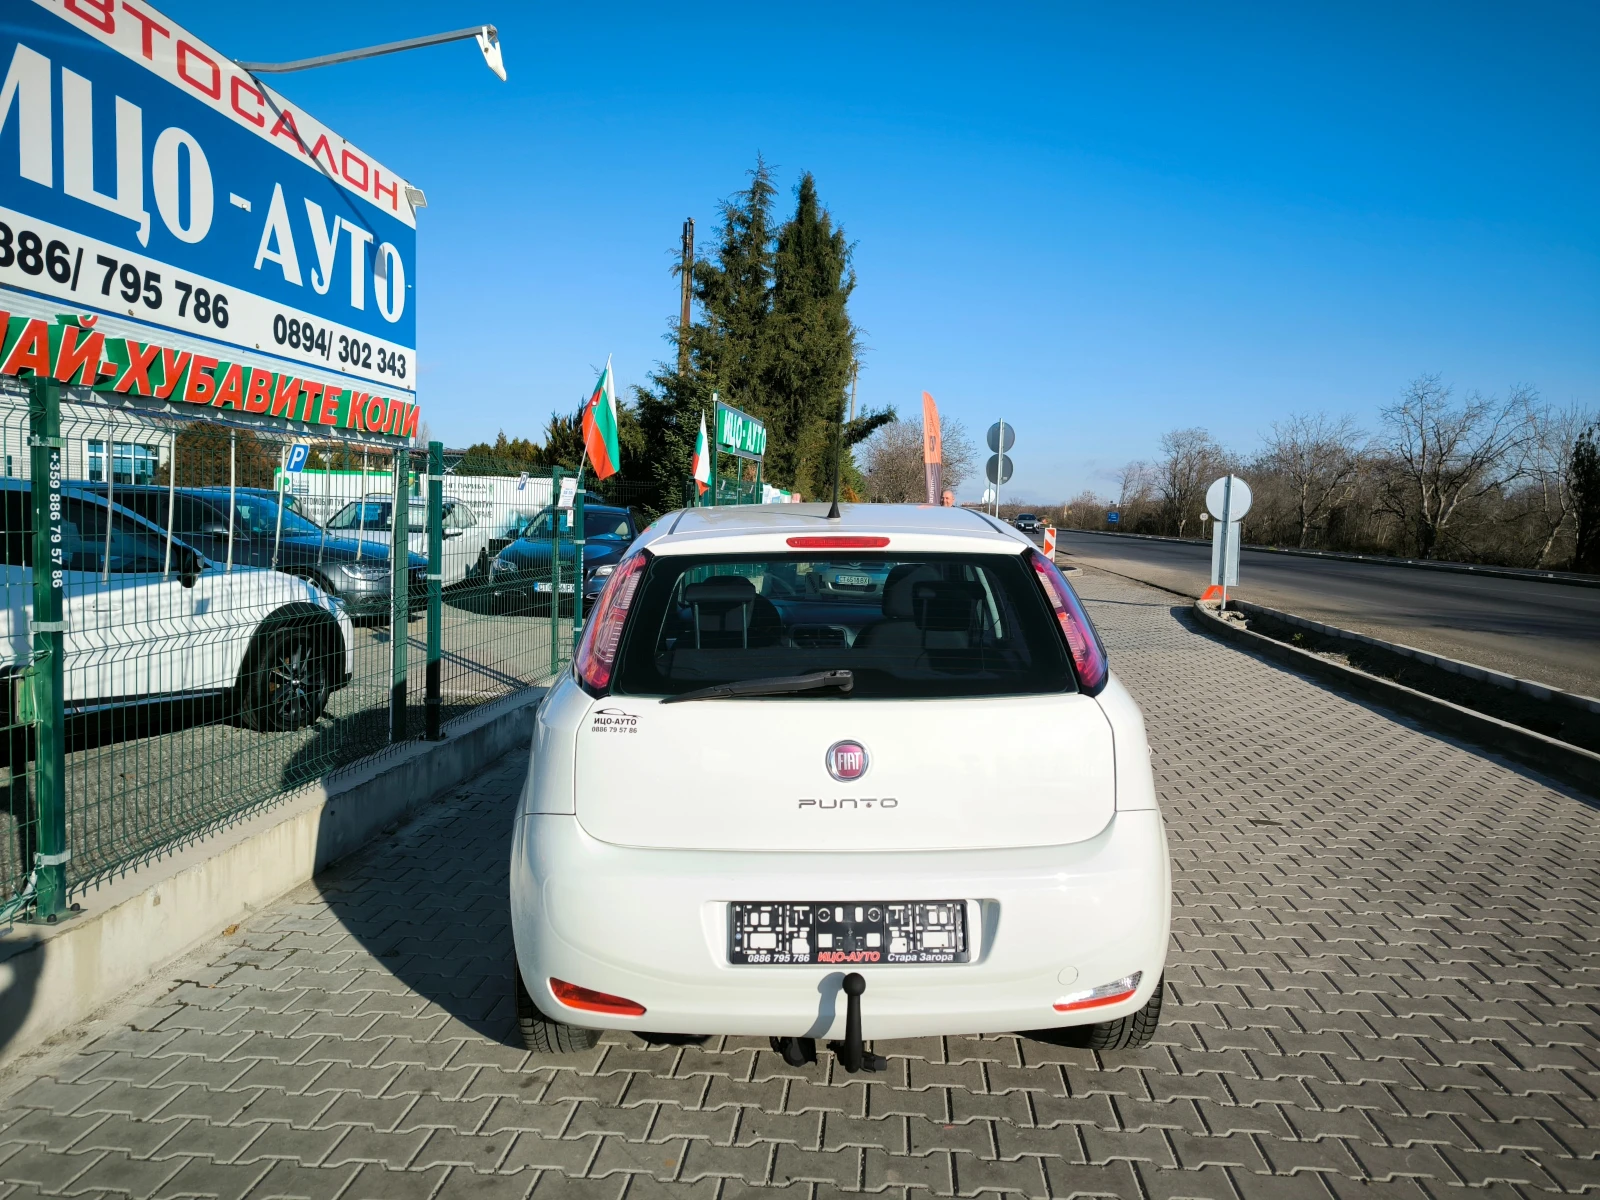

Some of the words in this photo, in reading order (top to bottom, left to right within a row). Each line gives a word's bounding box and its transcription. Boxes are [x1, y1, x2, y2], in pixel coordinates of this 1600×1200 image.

[50, 0, 398, 211] ВТОСАЛОН
[96, 254, 162, 310] 795
[175, 280, 229, 329] 786
[273, 314, 333, 361] 0894/
[338, 335, 372, 369] 302
[377, 347, 406, 379] 343
[0, 310, 342, 425] АЙ-ХУБАВИТЕ
[346, 391, 420, 438] КОЛИ
[723, 409, 767, 456] ИЦО-АУТО
[49, 452, 61, 489] +359
[49, 493, 61, 521] 886
[50, 525, 62, 543] 79
[51, 548, 62, 565] 57
[51, 570, 63, 588] 86
[594, 717, 637, 725] ИЦО-АУТО
[837, 752, 861, 770] FIAT
[798, 798, 899, 809] PUNTO
[747, 954, 771, 963] 0886
[773, 954, 791, 963] 795
[792, 954, 810, 963] 786
[818, 951, 881, 963] ИЦО-АУТО
[887, 953, 918, 963] Стара
[919, 953, 954, 963] Загора
